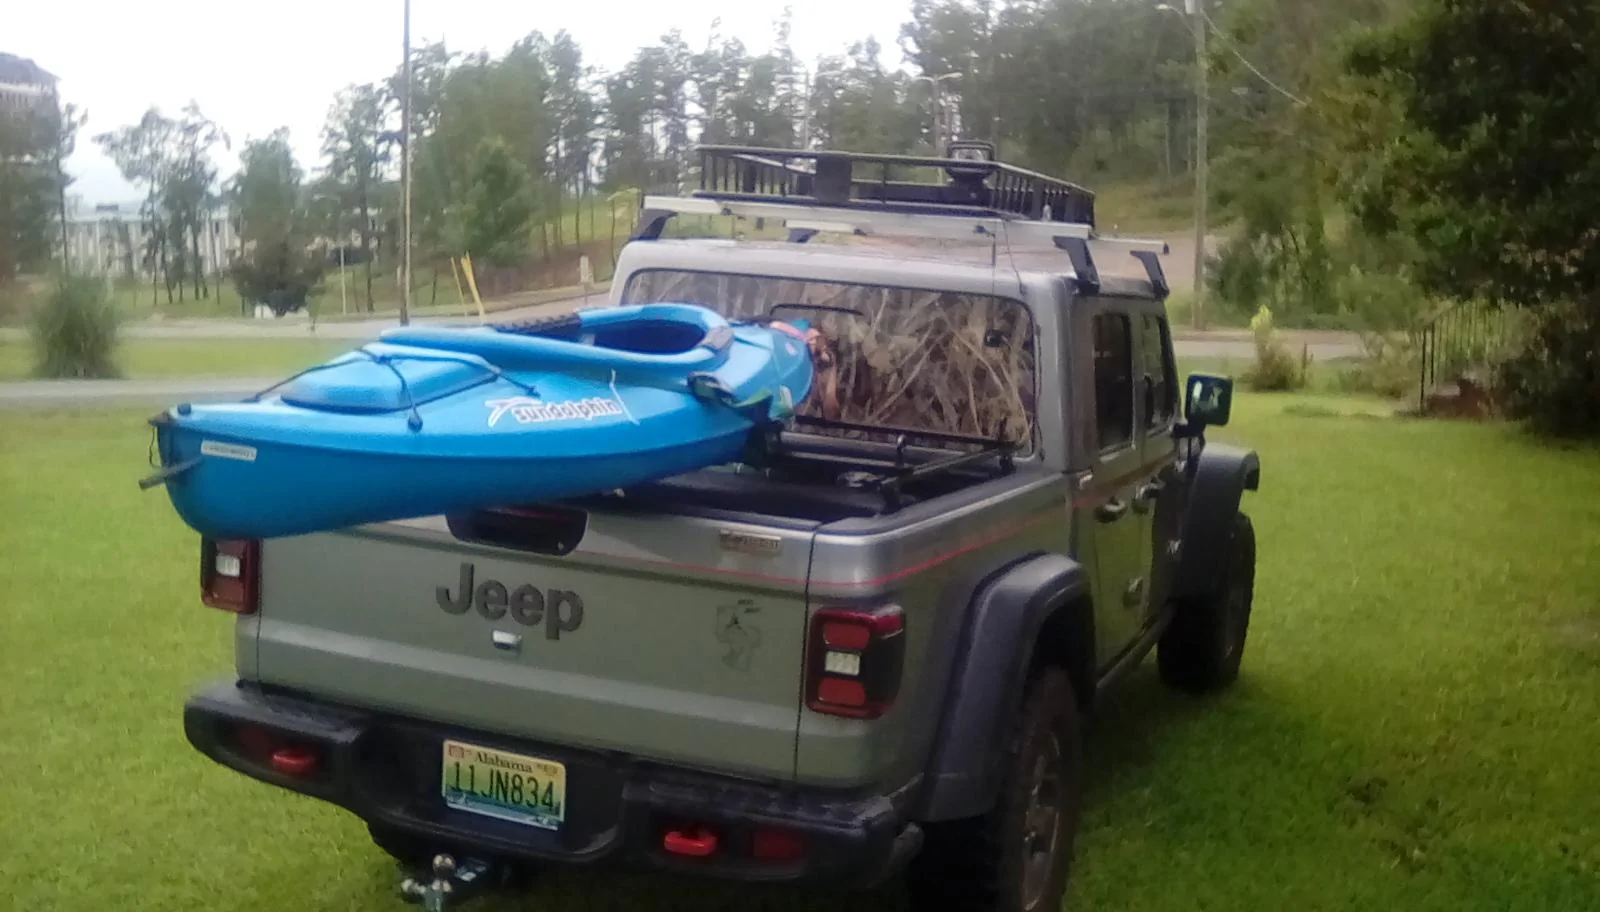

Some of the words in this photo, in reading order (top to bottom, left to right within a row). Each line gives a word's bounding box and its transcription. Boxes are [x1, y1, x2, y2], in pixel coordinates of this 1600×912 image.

[513, 398, 621, 423] sundolphin
[436, 562, 584, 640] Jeep
[475, 751, 533, 773] Alabama
[453, 761, 554, 809] 11JN834
